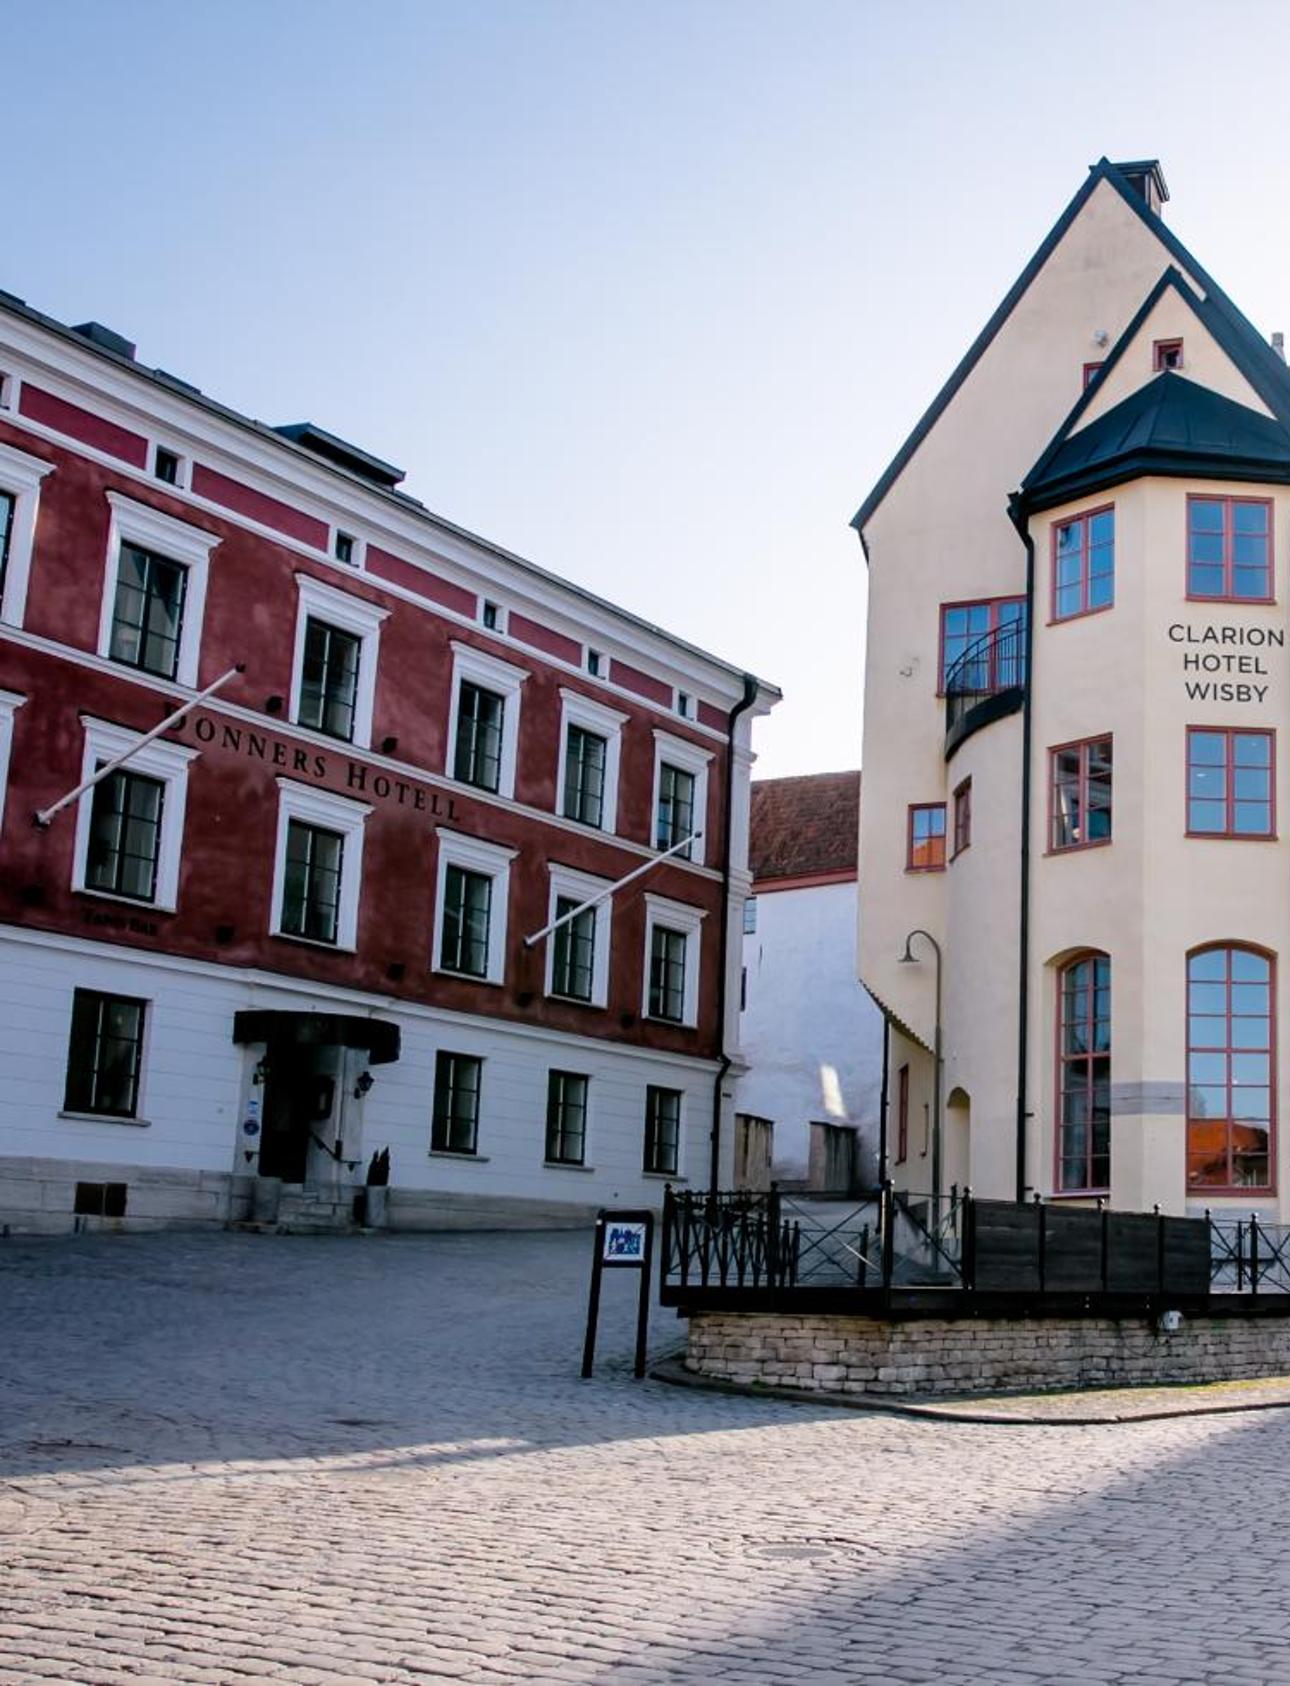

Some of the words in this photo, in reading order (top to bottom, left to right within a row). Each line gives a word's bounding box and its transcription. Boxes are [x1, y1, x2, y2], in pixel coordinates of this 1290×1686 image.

[1168, 624, 1285, 647] CLARION
[1183, 653, 1268, 675] HOTEL
[1184, 682, 1269, 703] WISBY
[346, 761, 460, 822] HOTELL
